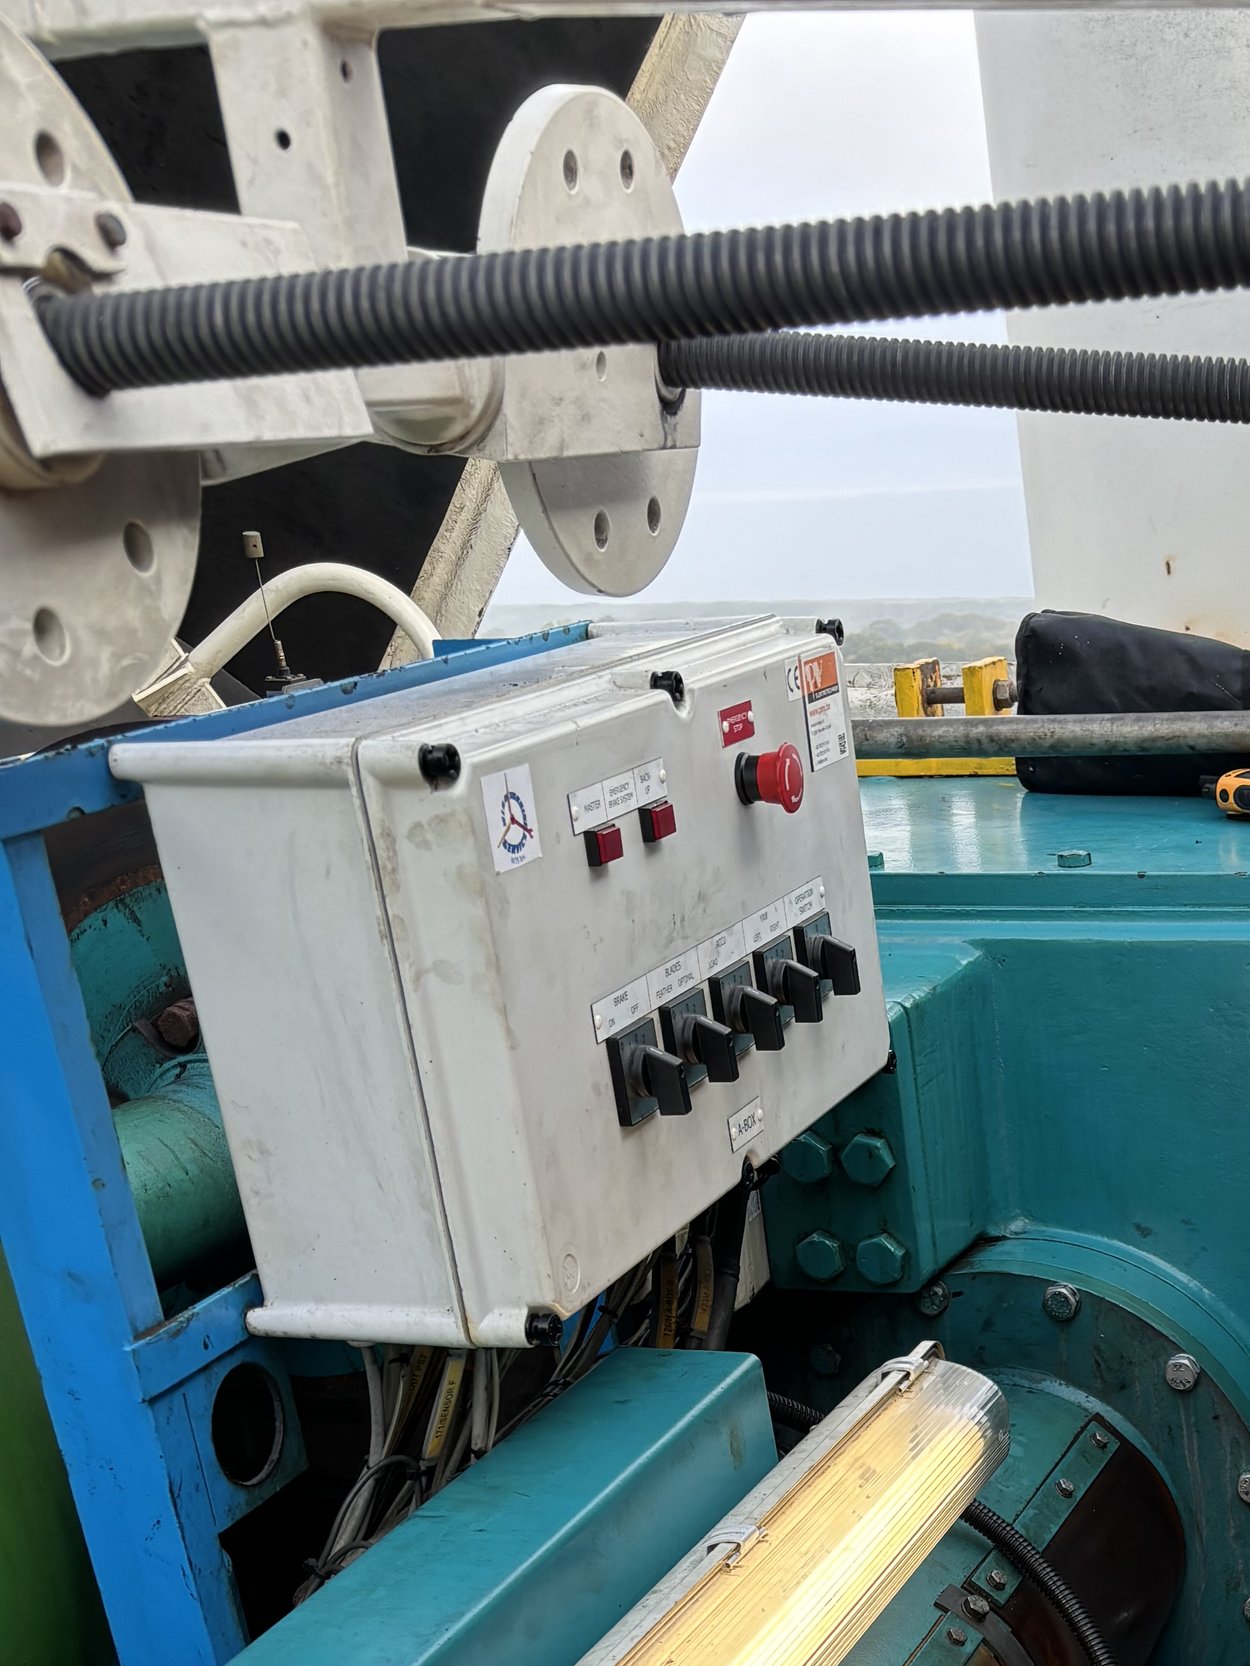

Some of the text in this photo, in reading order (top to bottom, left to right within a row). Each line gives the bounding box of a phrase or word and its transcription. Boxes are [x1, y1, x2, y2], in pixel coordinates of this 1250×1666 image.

[664, 960, 683, 977] BLADES
[613, 990, 629, 1007] BRAKE
[737, 1111, 757, 1137] A-BOX
